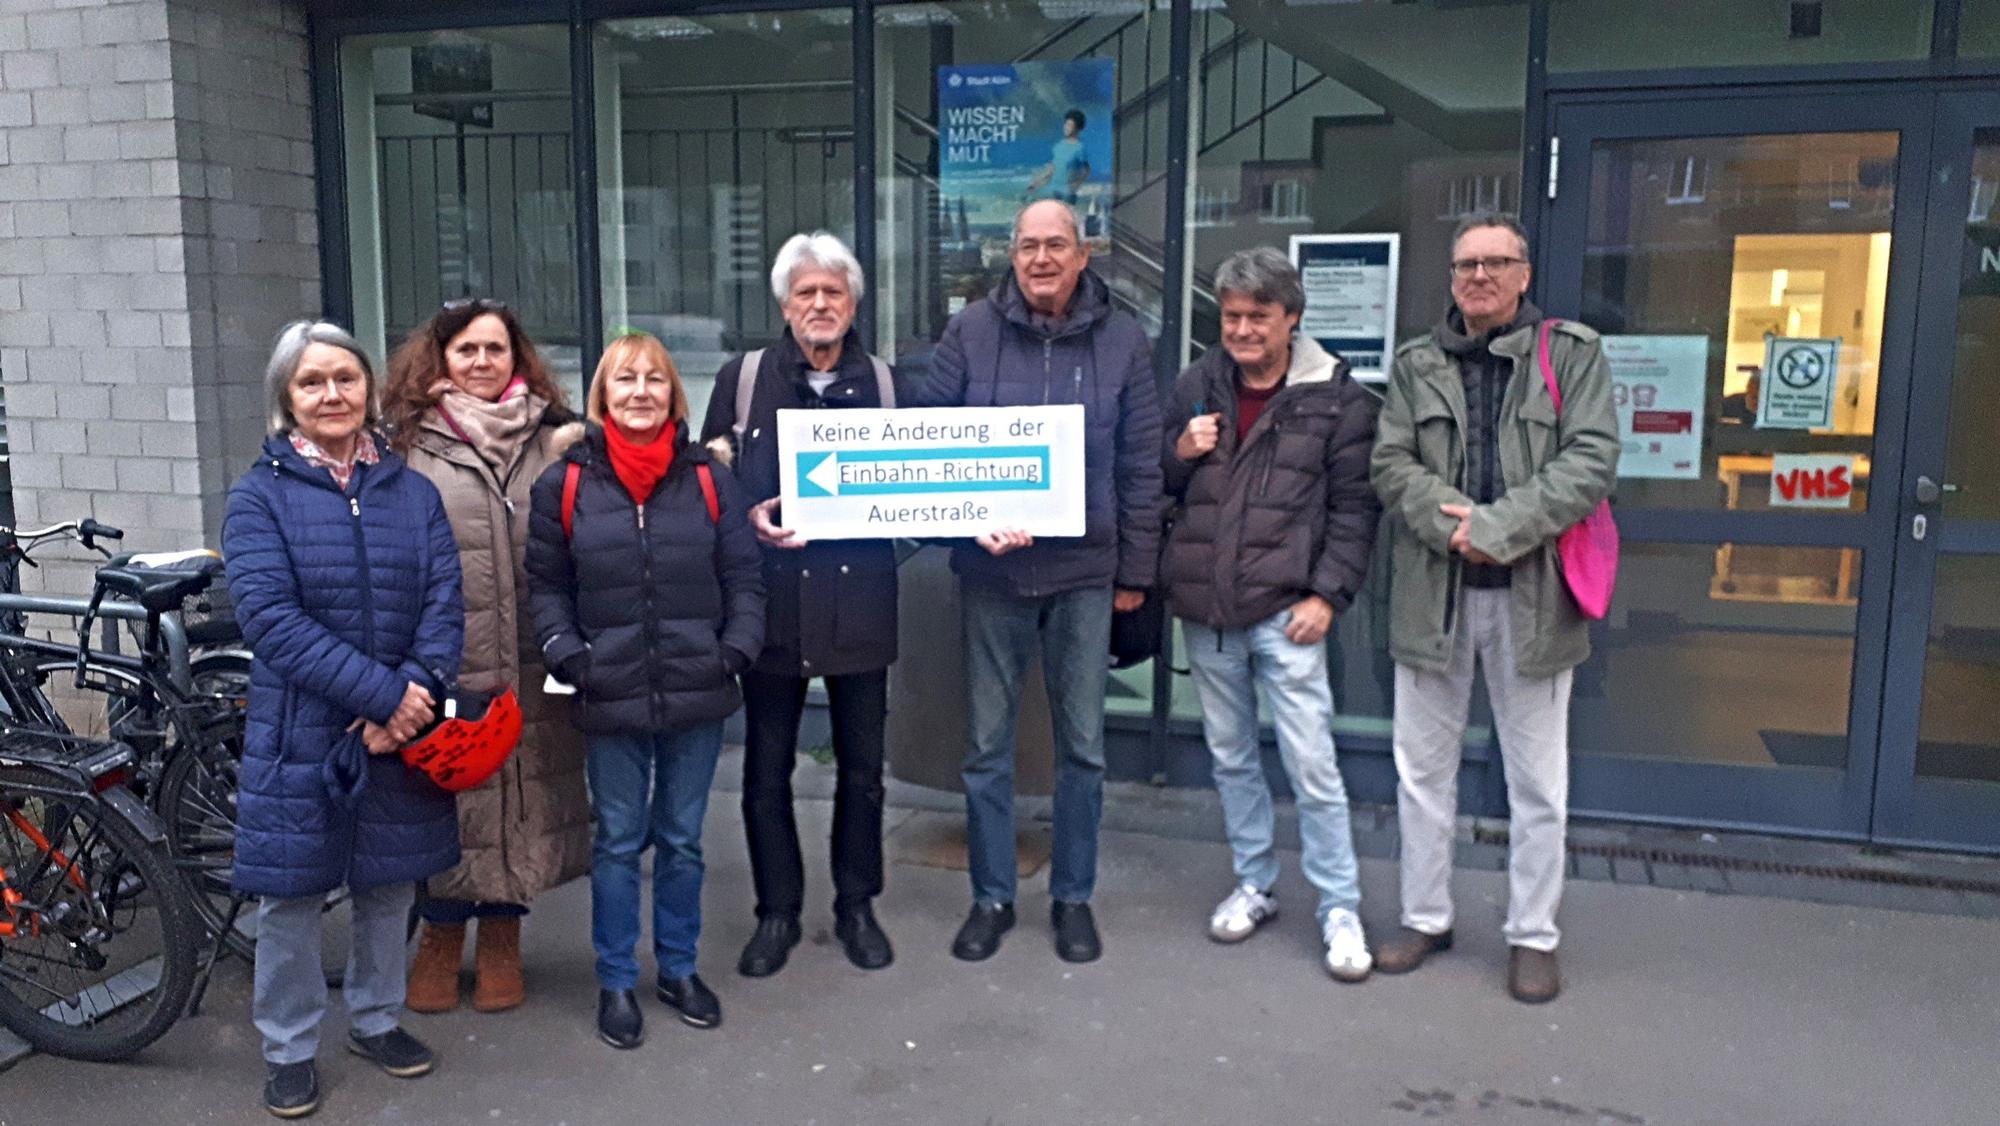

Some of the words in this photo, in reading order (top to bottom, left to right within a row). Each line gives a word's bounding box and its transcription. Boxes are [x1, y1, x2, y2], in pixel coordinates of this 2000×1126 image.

[948, 106, 1024, 126] WISSEN
[948, 125, 1019, 144] MACHT
[948, 144, 991, 163] MUT
[813, 423, 870, 442] Keine
[882, 418, 989, 443] Änderung
[1009, 417, 1044, 436] der
[1776, 466, 1852, 501] VHS
[868, 501, 989, 522] Auerstraße
